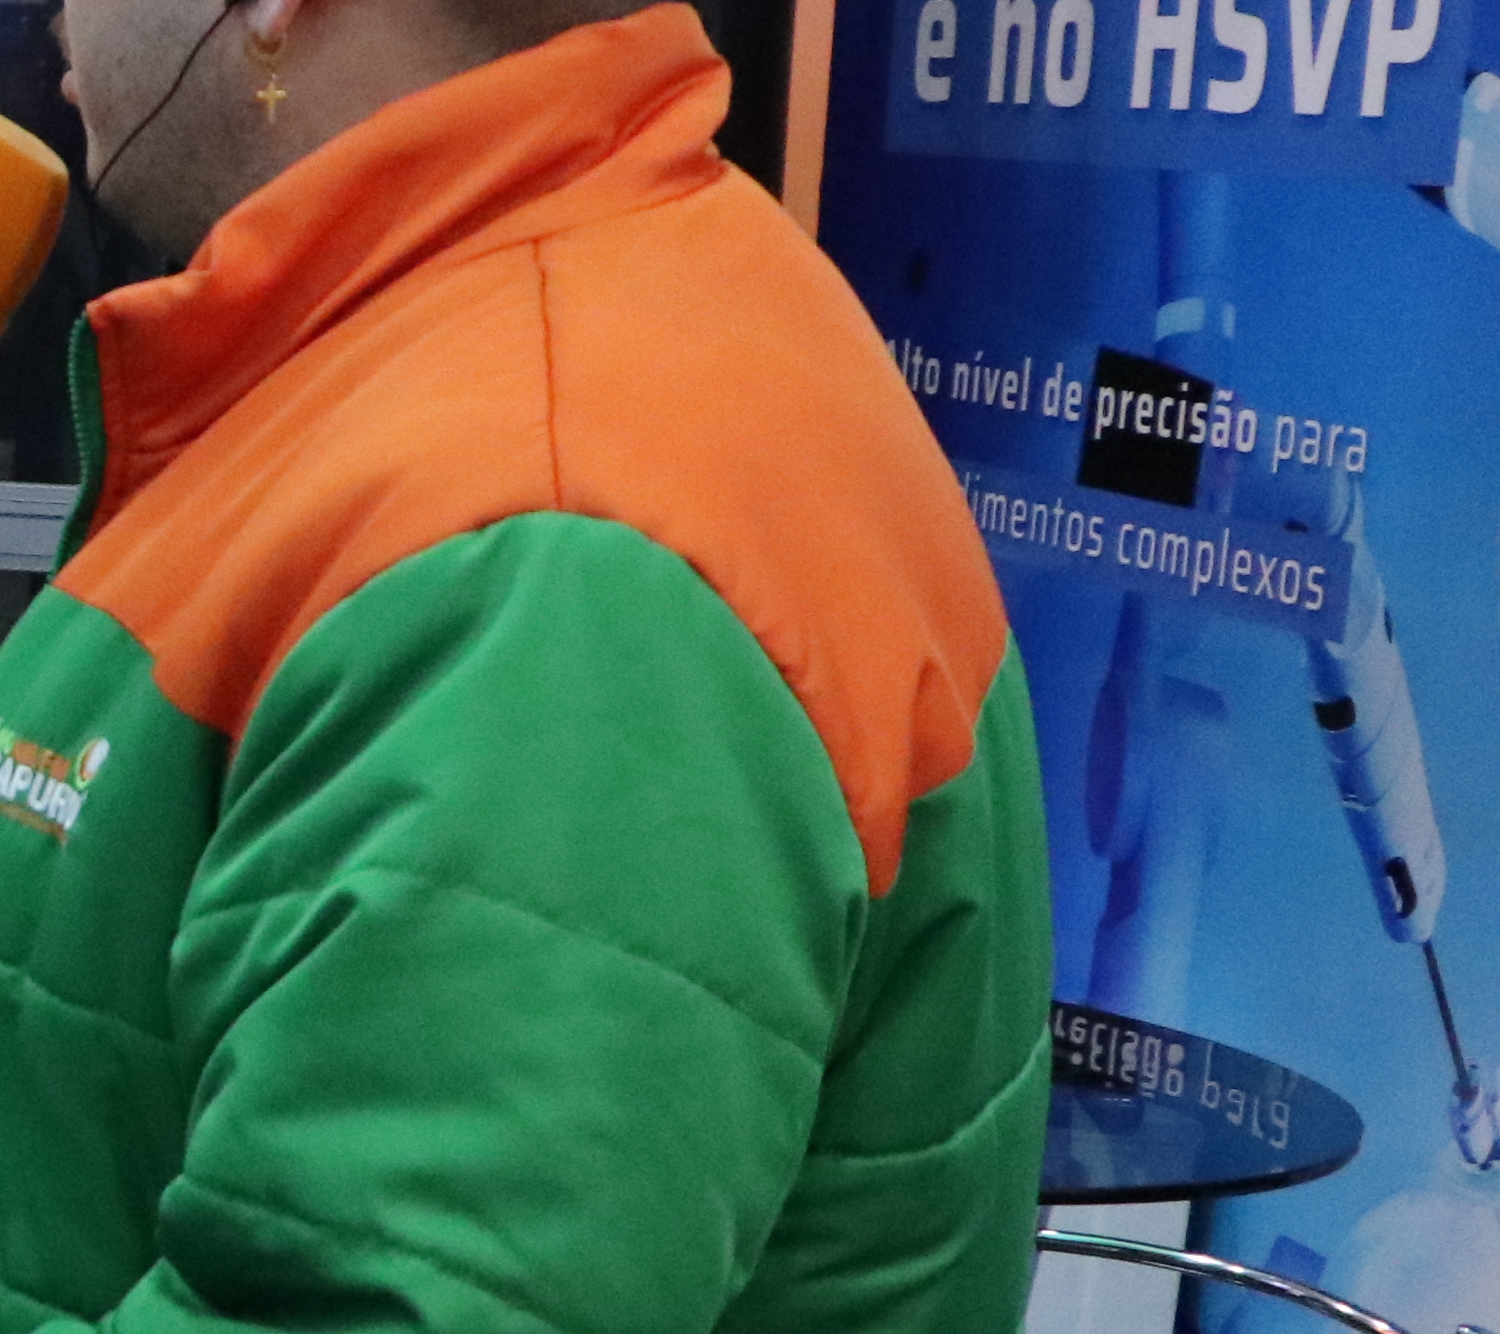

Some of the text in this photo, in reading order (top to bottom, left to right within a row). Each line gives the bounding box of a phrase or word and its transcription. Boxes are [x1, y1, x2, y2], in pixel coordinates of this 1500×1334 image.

[953, 350, 1030, 411] nível
[1043, 361, 1083, 422] de
[1094, 381, 1259, 453] precisão
[1271, 413, 1368, 473] para
[1117, 527, 1326, 611] complexos
